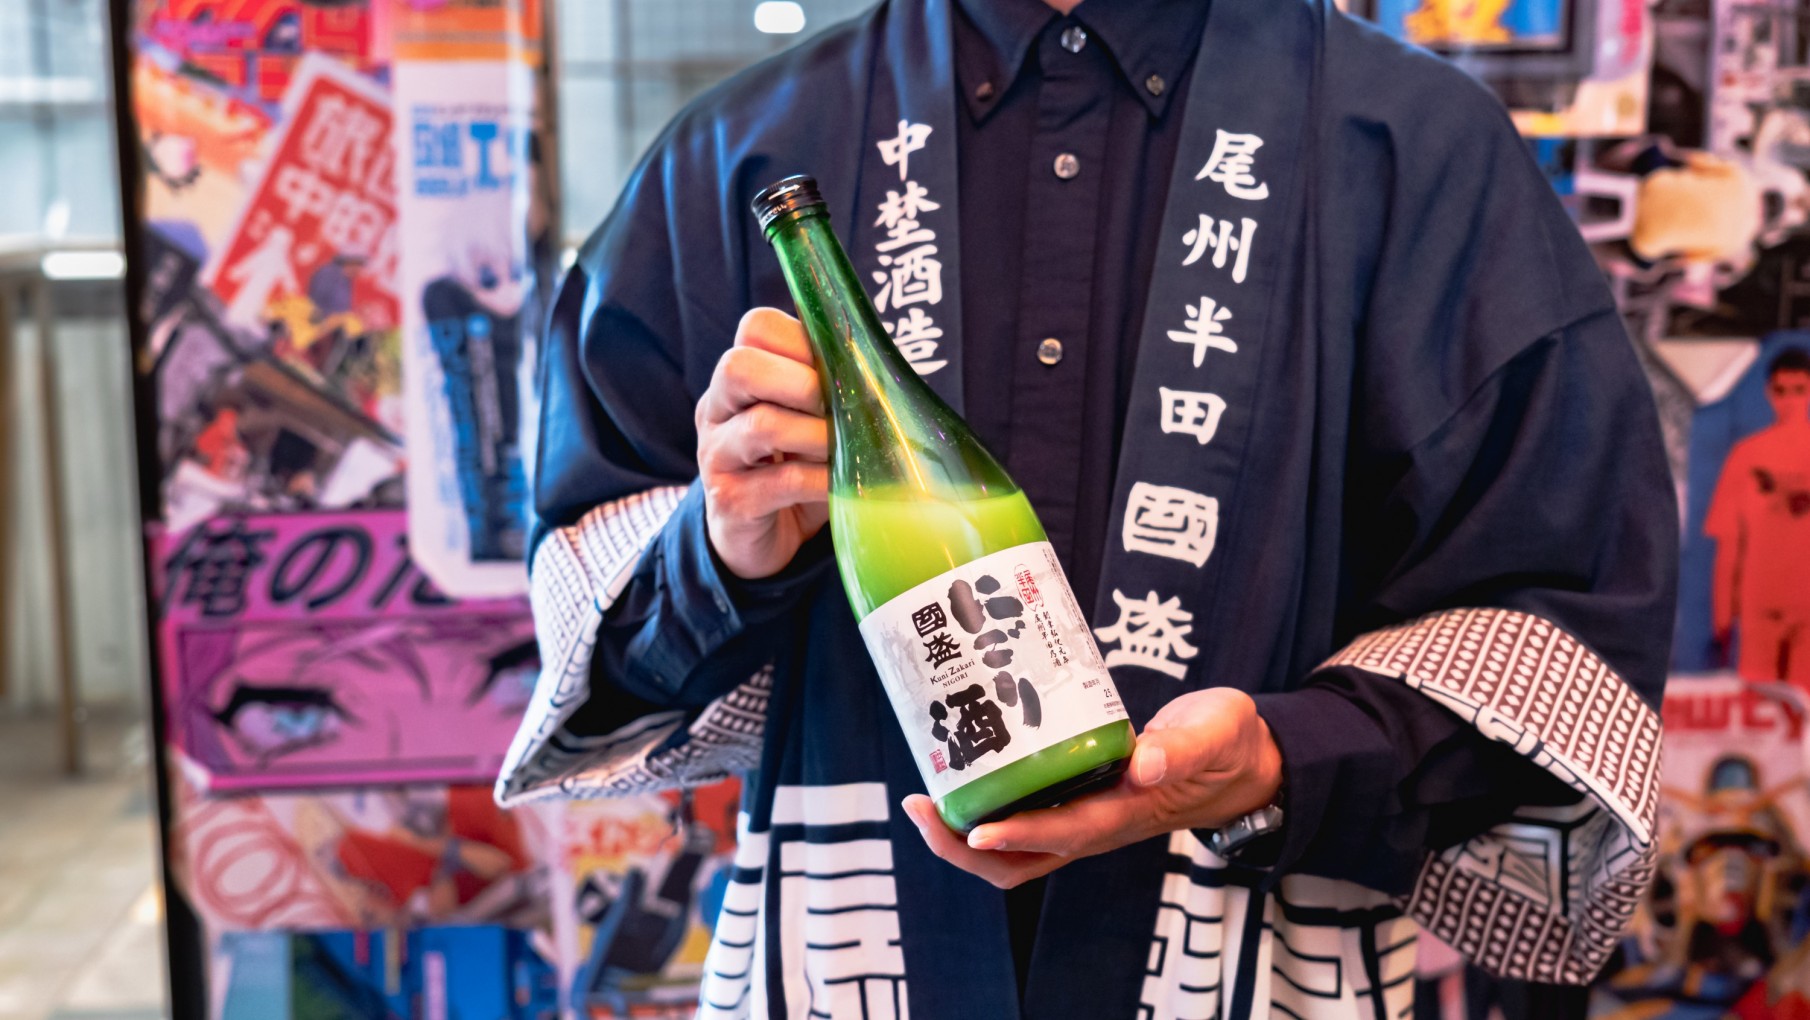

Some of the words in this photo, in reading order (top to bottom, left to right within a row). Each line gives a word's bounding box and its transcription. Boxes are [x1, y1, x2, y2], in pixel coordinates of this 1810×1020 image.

[872, 120, 948, 376] 中埜酒造
[1158, 128, 1269, 445] 尾州半田
[912, 602, 962, 669] 國盛
[1093, 481, 1219, 680] 國盛
[930, 671, 949, 685] Kuni
[948, 659, 975, 676] Zakari
[942, 672, 968, 688] NIGORI
